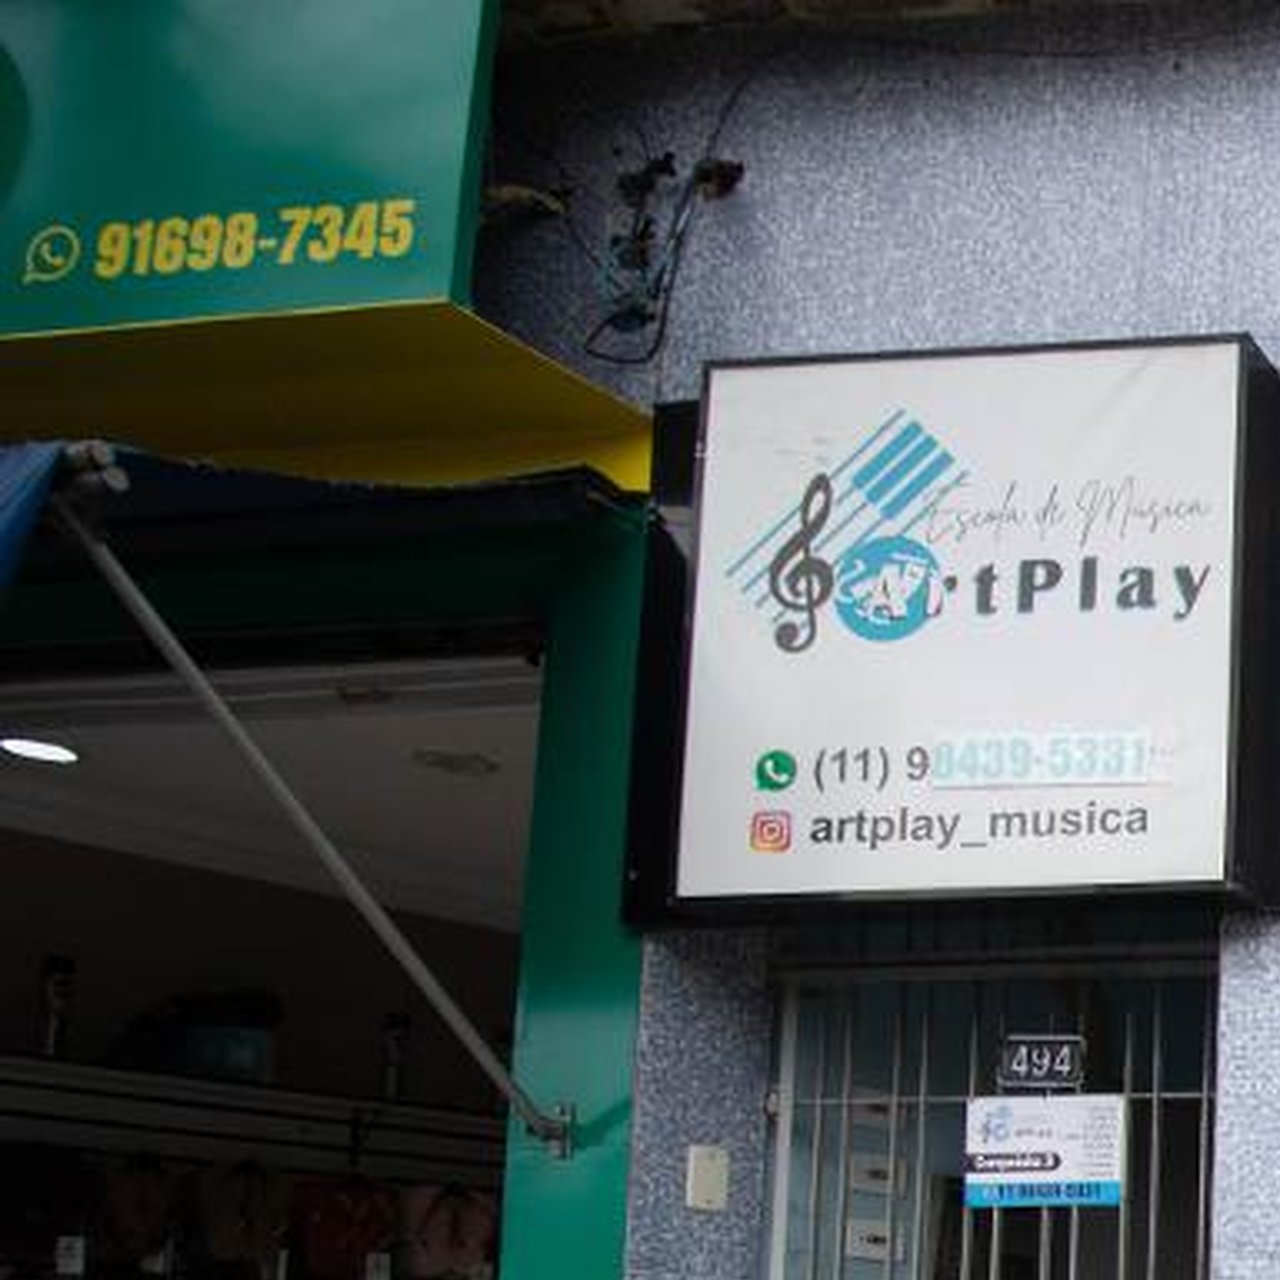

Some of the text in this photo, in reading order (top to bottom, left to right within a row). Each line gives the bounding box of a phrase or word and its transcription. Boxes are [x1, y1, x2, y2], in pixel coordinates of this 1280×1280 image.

[95, 200, 415, 279] 91698-7345
[922, 478, 1026, 544] Escola
[1033, 484, 1066, 541] de
[813, 746, 891, 793] (11)
[810, 801, 1149, 850] artplay_musica
[1012, 1045, 1072, 1077] 494
